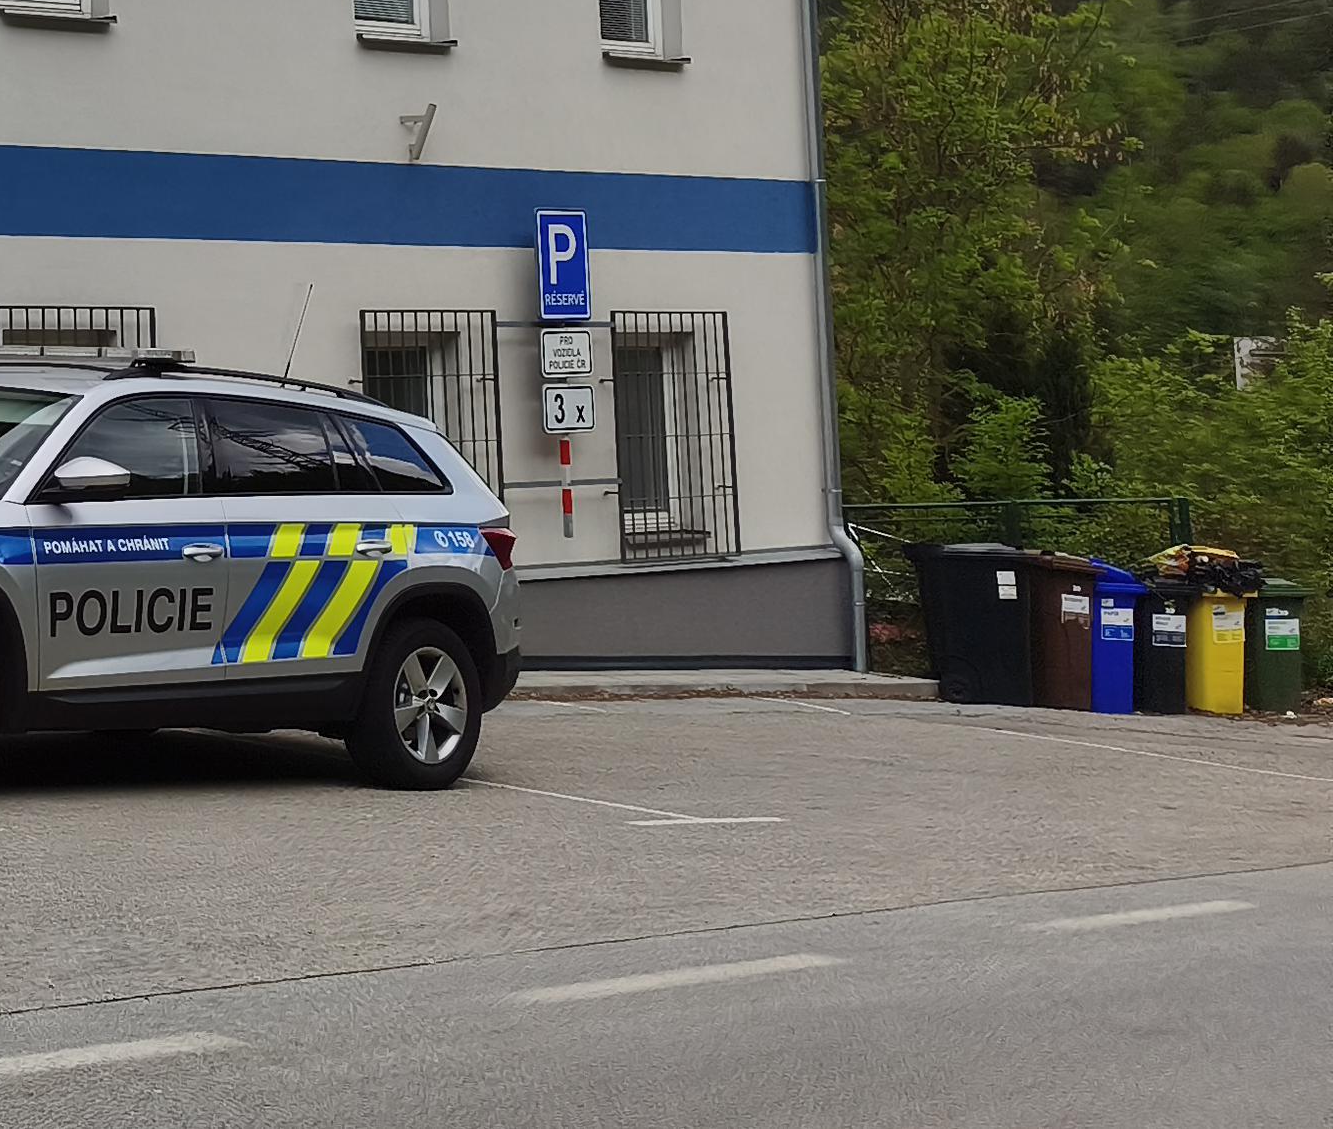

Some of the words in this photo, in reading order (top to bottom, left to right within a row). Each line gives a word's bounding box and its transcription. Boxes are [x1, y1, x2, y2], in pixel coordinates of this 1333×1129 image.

[547, 223, 577, 285] P
[545, 290, 585, 306] RÉSERVÉ
[559, 335, 574, 346] PRO
[552, 348, 582, 358] VOZIDLA
[549, 360, 575, 370] POLICIE
[576, 358, 587, 369] ČR
[553, 393, 565, 424] 3
[44, 537, 103, 555] POMÁHAT
[106, 540, 117, 553] A
[118, 534, 170, 551] CHRÁNIT
[447, 530, 475, 548] 158
[49, 587, 214, 637] POLICIE
